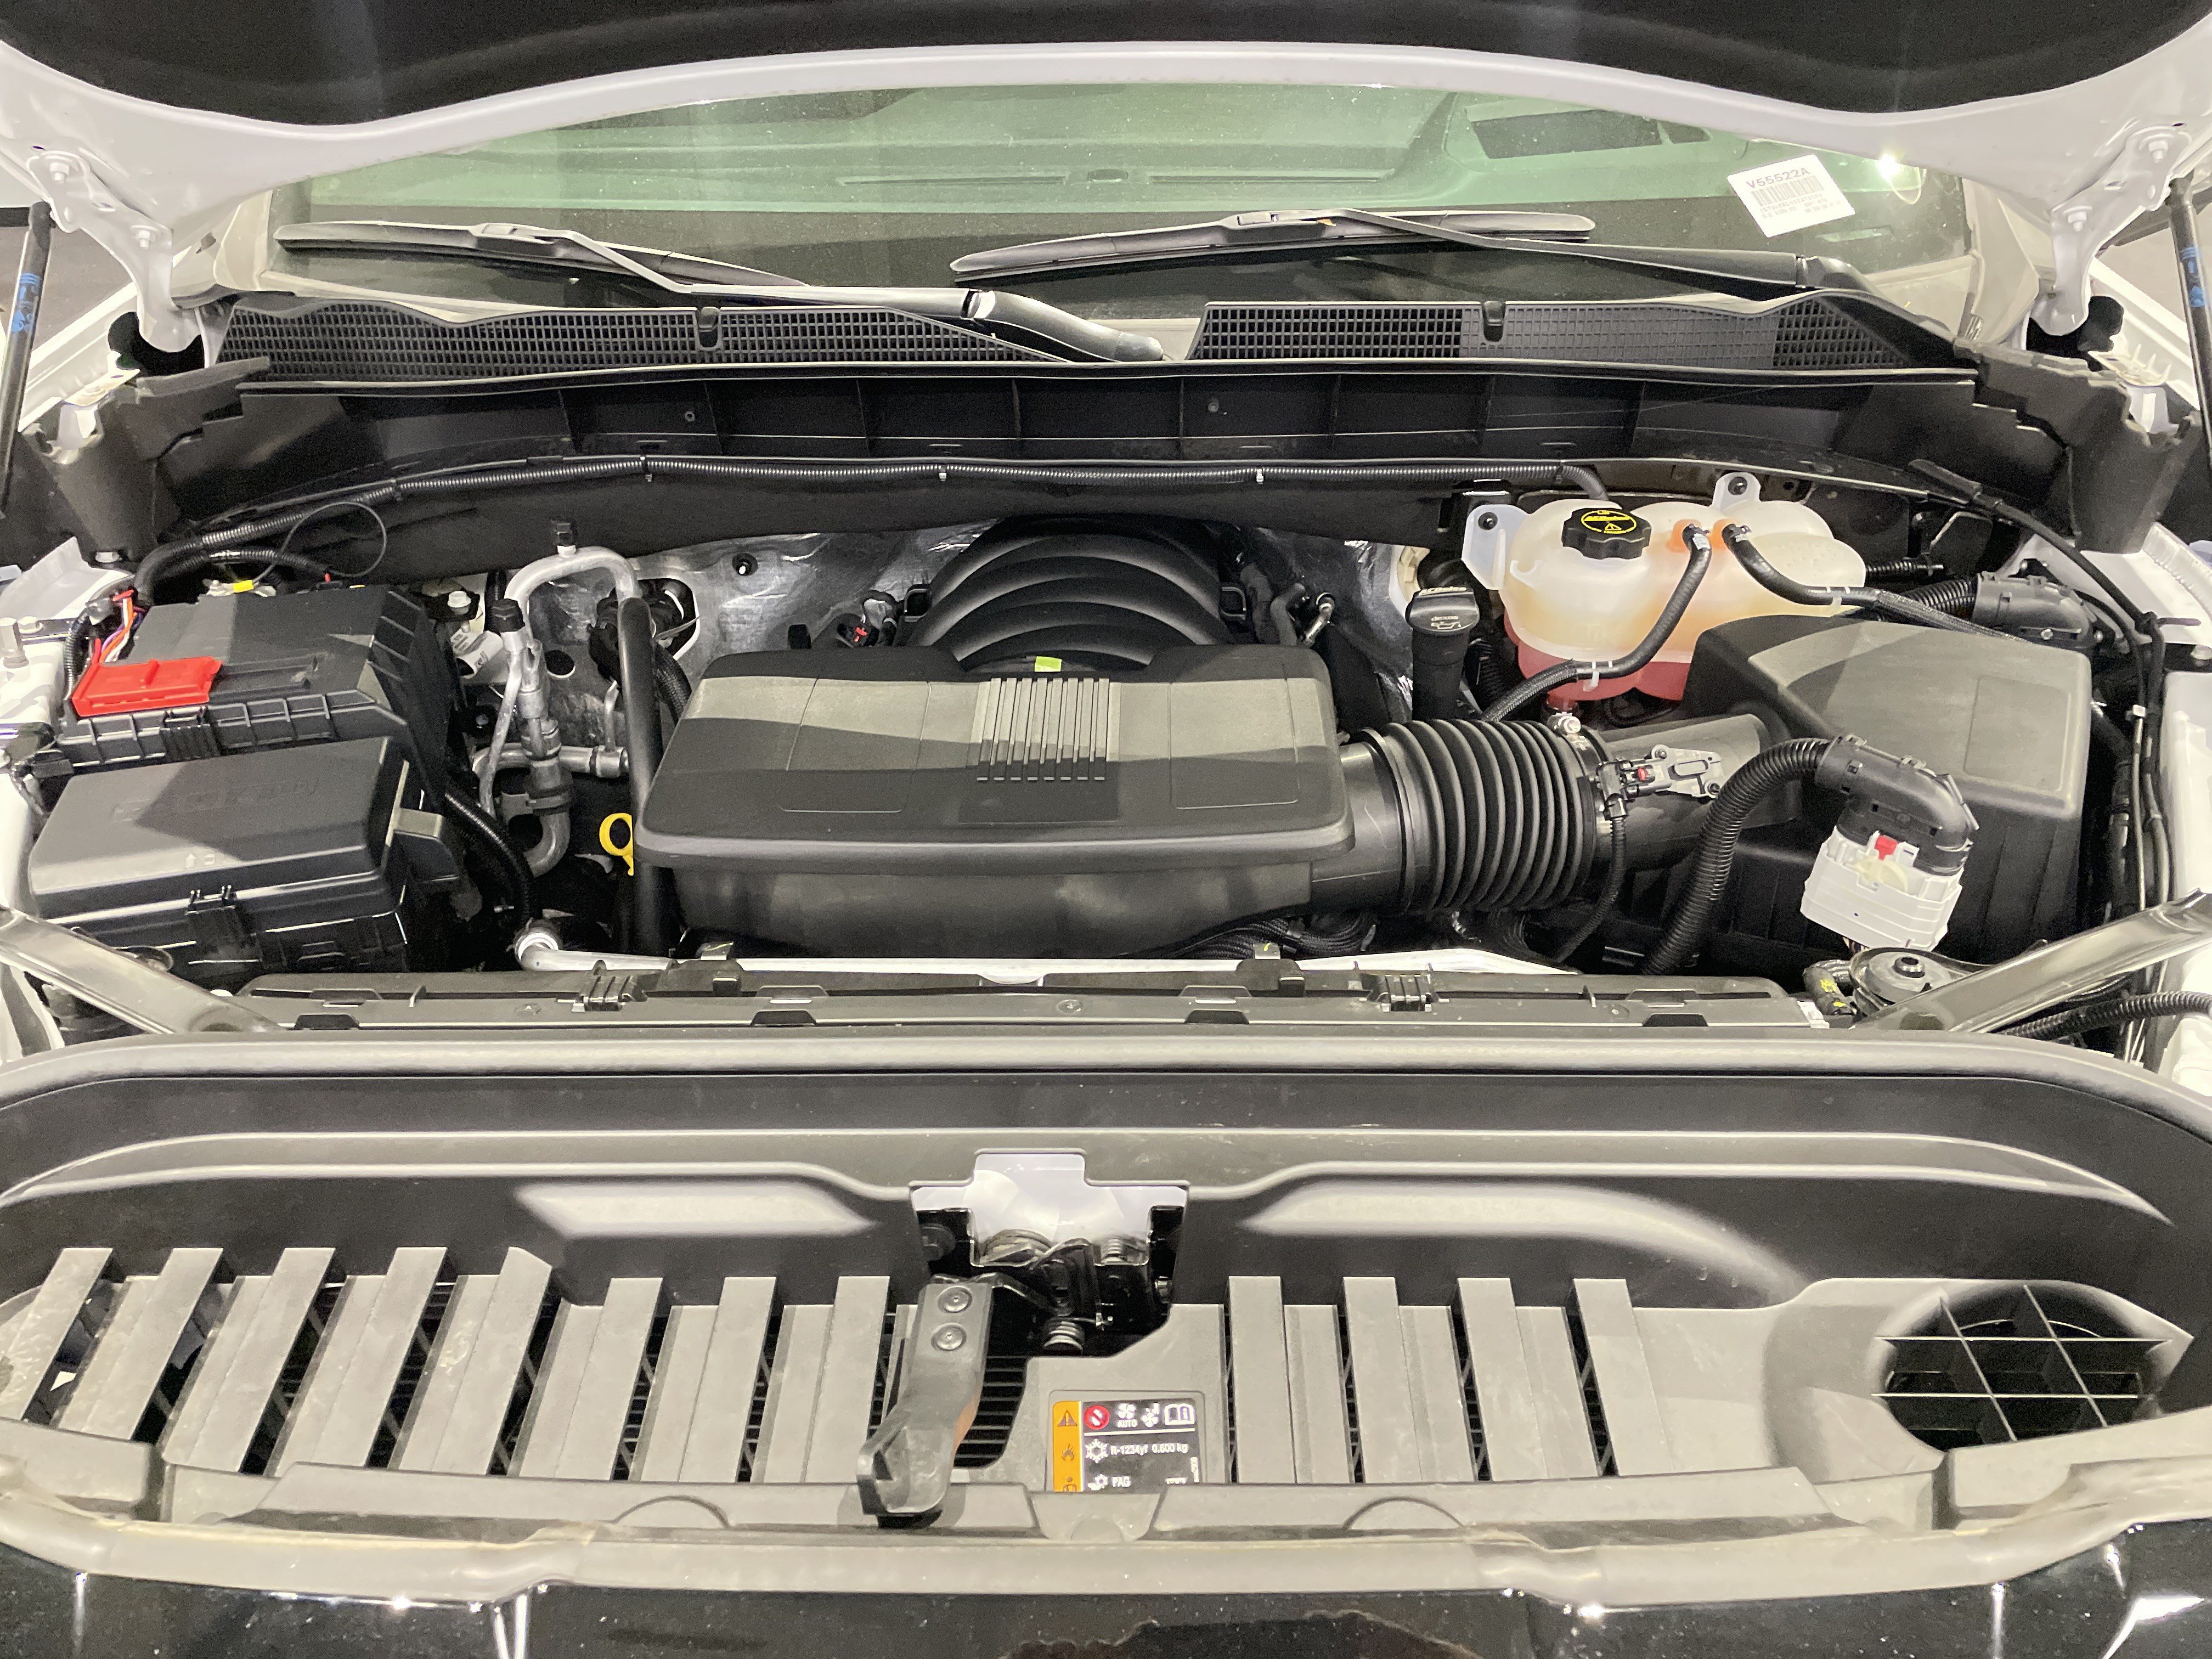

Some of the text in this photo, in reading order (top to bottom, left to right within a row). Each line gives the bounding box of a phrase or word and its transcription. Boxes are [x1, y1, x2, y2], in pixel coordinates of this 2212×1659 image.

[1746, 168, 1810, 189] V55522A
[1117, 1419, 1138, 1427] AUTO
[1110, 1443, 1189, 1455] R-1234yf 0.600 kg
[1112, 1476, 1131, 1487] PAG
